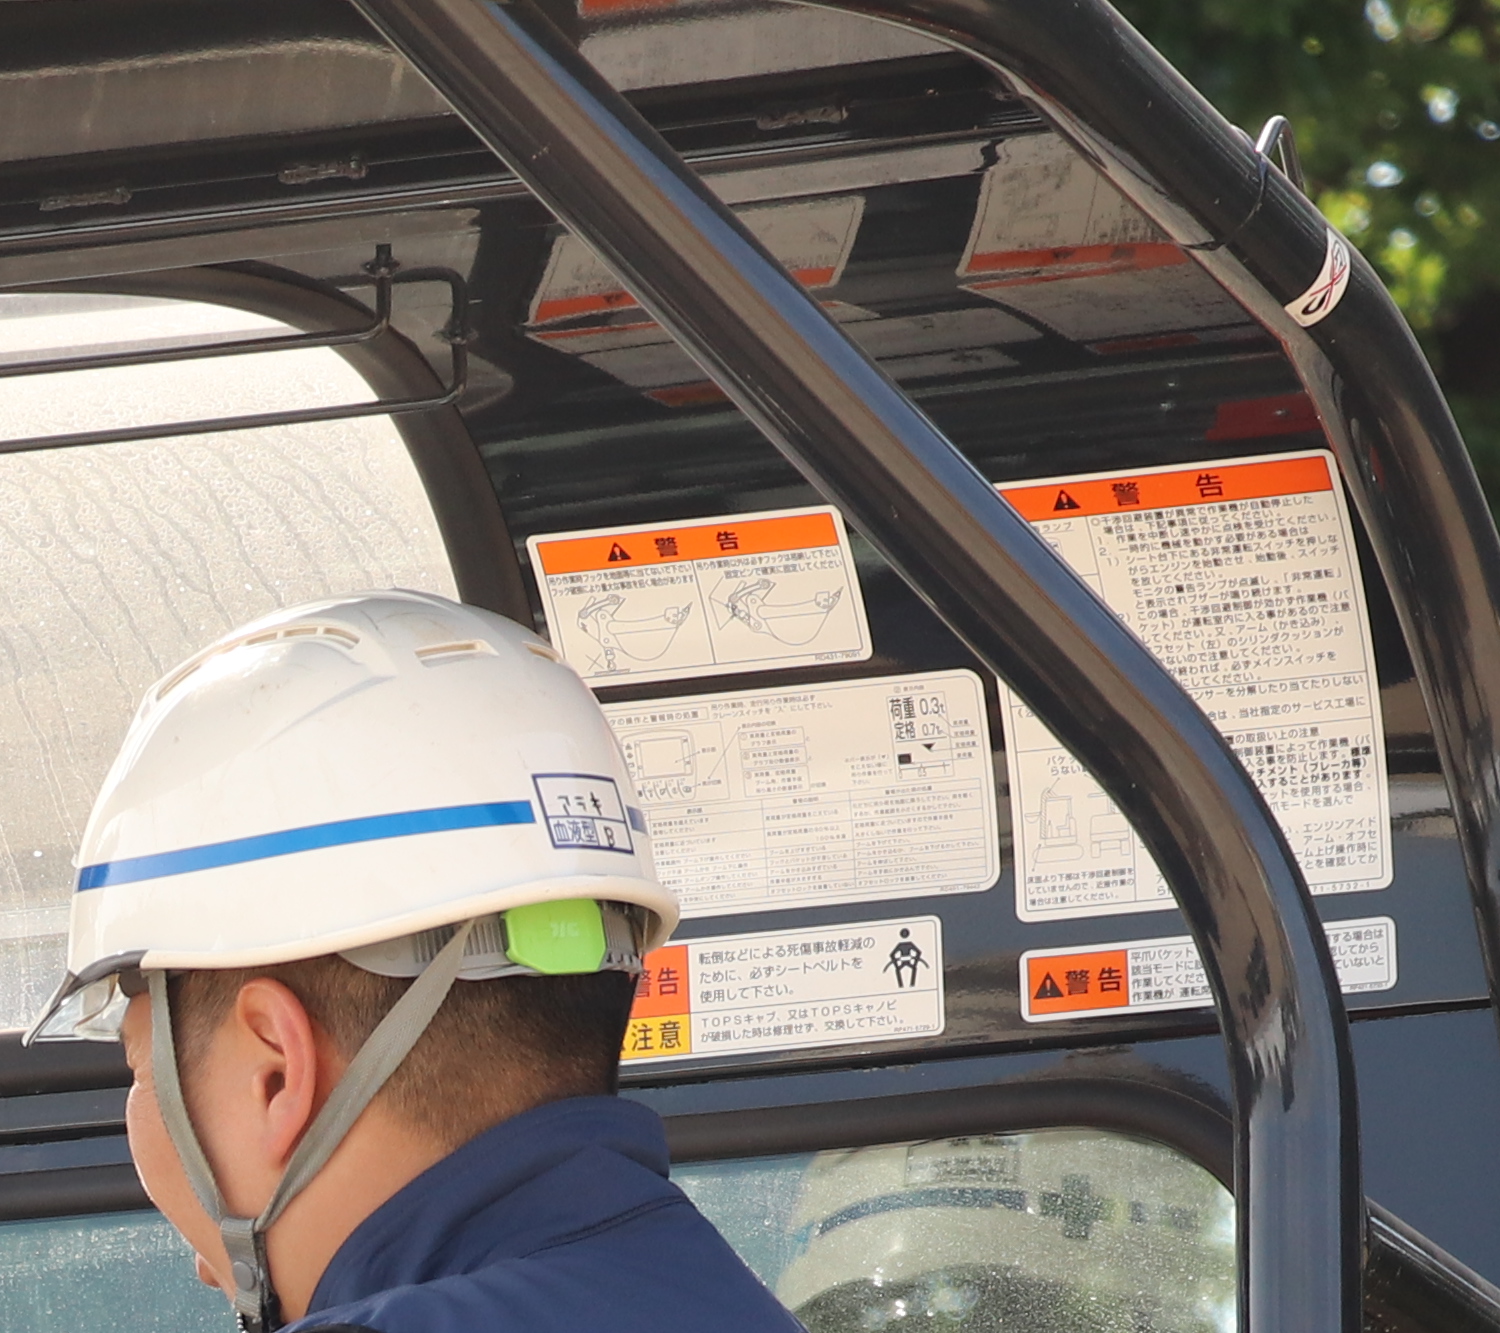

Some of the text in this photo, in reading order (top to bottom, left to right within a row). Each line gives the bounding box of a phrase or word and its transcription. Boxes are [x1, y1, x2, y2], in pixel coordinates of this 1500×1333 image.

[1111, 473, 1223, 506] 警告
[653, 530, 740, 558] 警告
[889, 696, 916, 721] 荷重
[554, 820, 598, 843] 血液型
[604, 826, 615, 847] B
[698, 936, 876, 966] 転倒などによる死傷事故軽減の
[699, 957, 863, 984] ために、必ずシートベルトを
[1064, 966, 1122, 996] 警告
[699, 984, 796, 1004] 使用して下さい。
[632, 1021, 682, 1052] 注意
